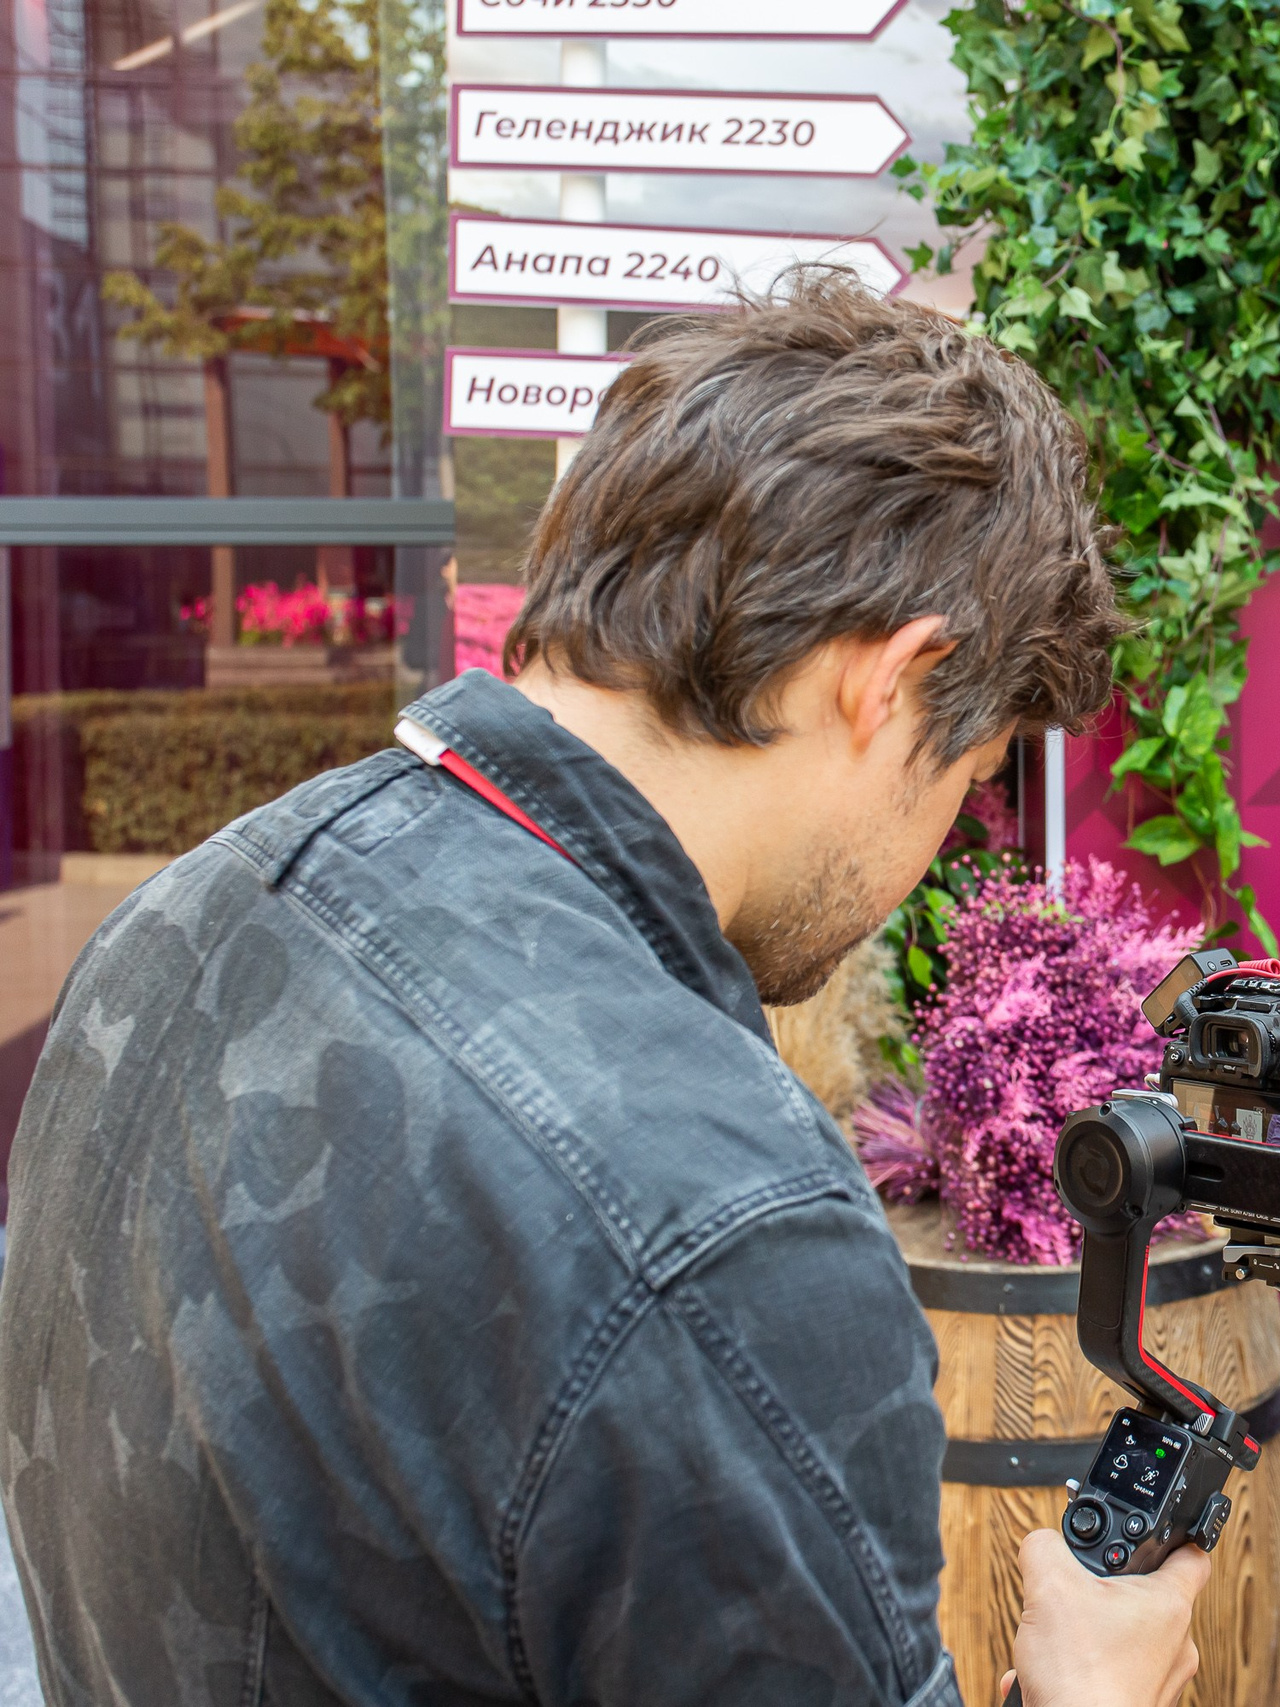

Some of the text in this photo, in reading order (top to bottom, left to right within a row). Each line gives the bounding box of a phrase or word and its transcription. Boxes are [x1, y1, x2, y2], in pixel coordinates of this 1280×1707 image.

[474, 110, 816, 147] Геленджик 2230
[470, 243, 720, 282] Анапа 2240
[1129, 1520, 1139, 1531] M
